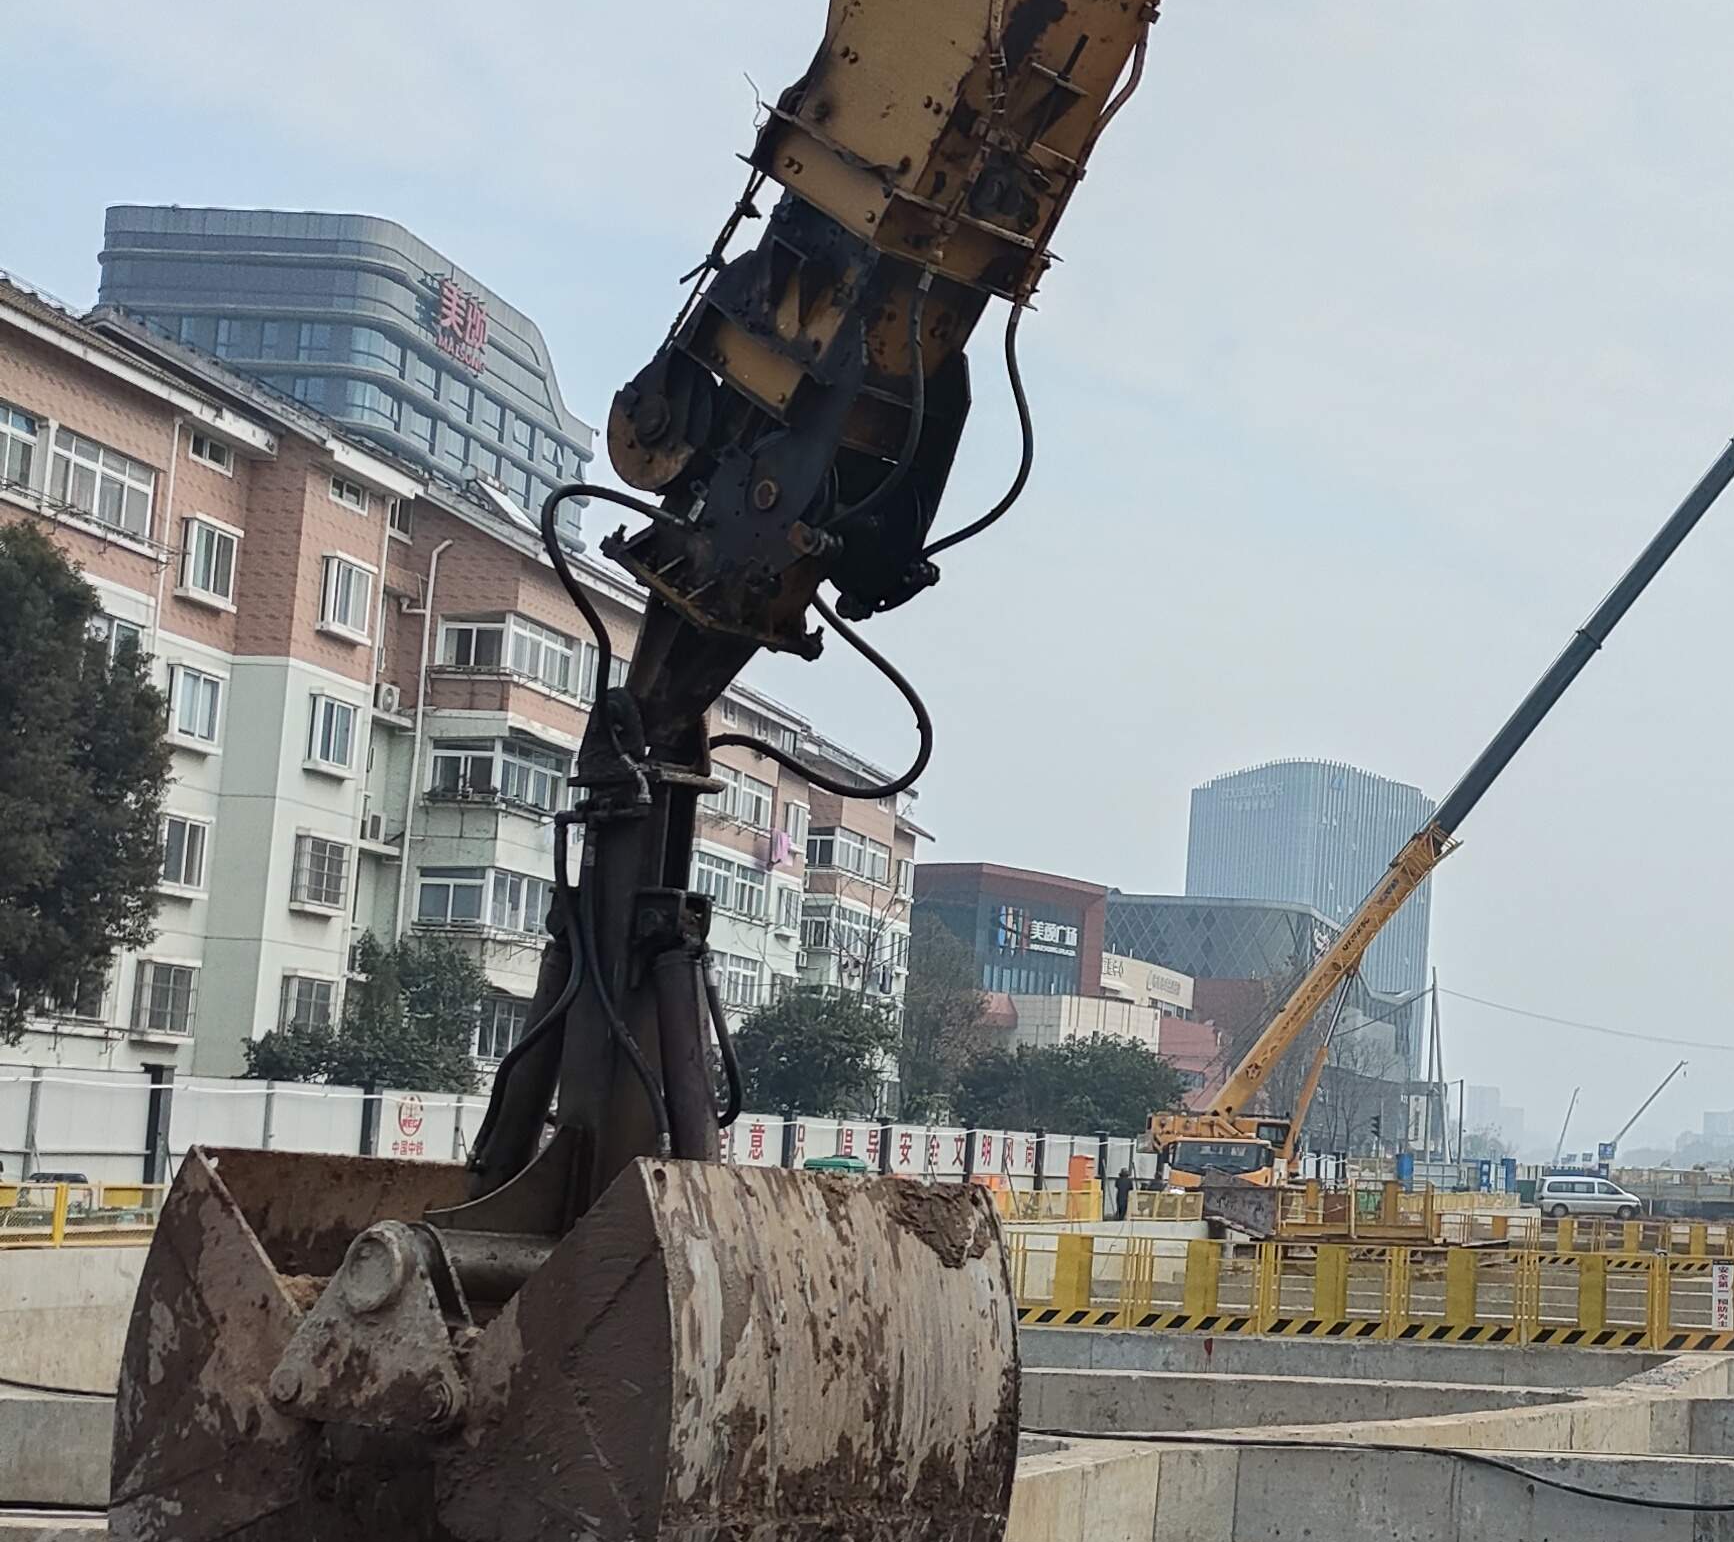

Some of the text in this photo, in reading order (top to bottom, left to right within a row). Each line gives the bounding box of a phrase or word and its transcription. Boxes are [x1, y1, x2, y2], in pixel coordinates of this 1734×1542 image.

[391, 1140, 424, 1156] 中国中铁
[1717, 1266, 1729, 1293] 安全第一
[1717, 1299, 1729, 1328] 预防为主
